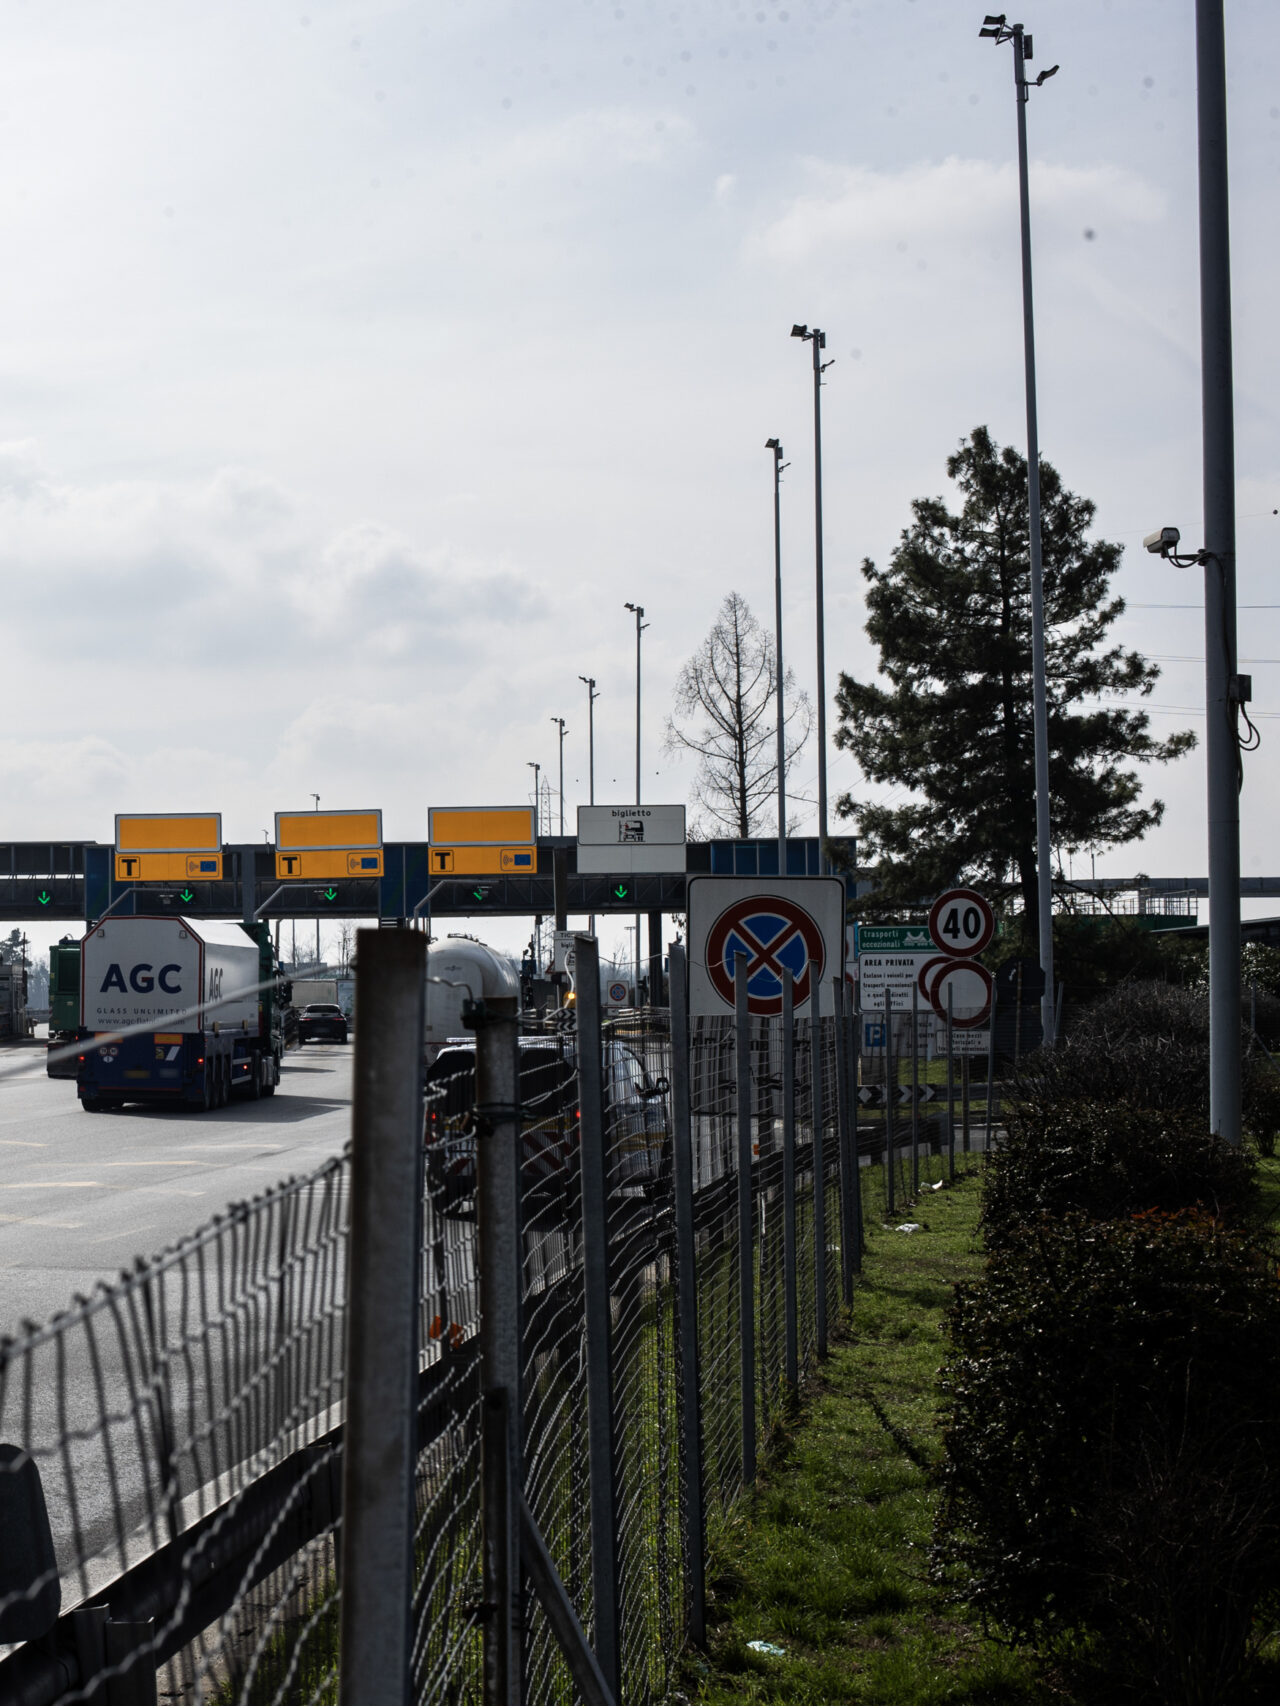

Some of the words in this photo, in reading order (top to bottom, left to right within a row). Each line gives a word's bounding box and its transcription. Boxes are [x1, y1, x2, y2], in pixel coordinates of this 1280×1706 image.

[612, 810, 651, 818] biglietto
[122, 859, 136, 876] T
[282, 857, 298, 874] T
[435, 852, 450, 870] T
[943, 907, 980, 939] 40
[864, 930, 898, 938] trasporti
[862, 940, 900, 948] eccezionali
[100, 964, 182, 994] AGC
